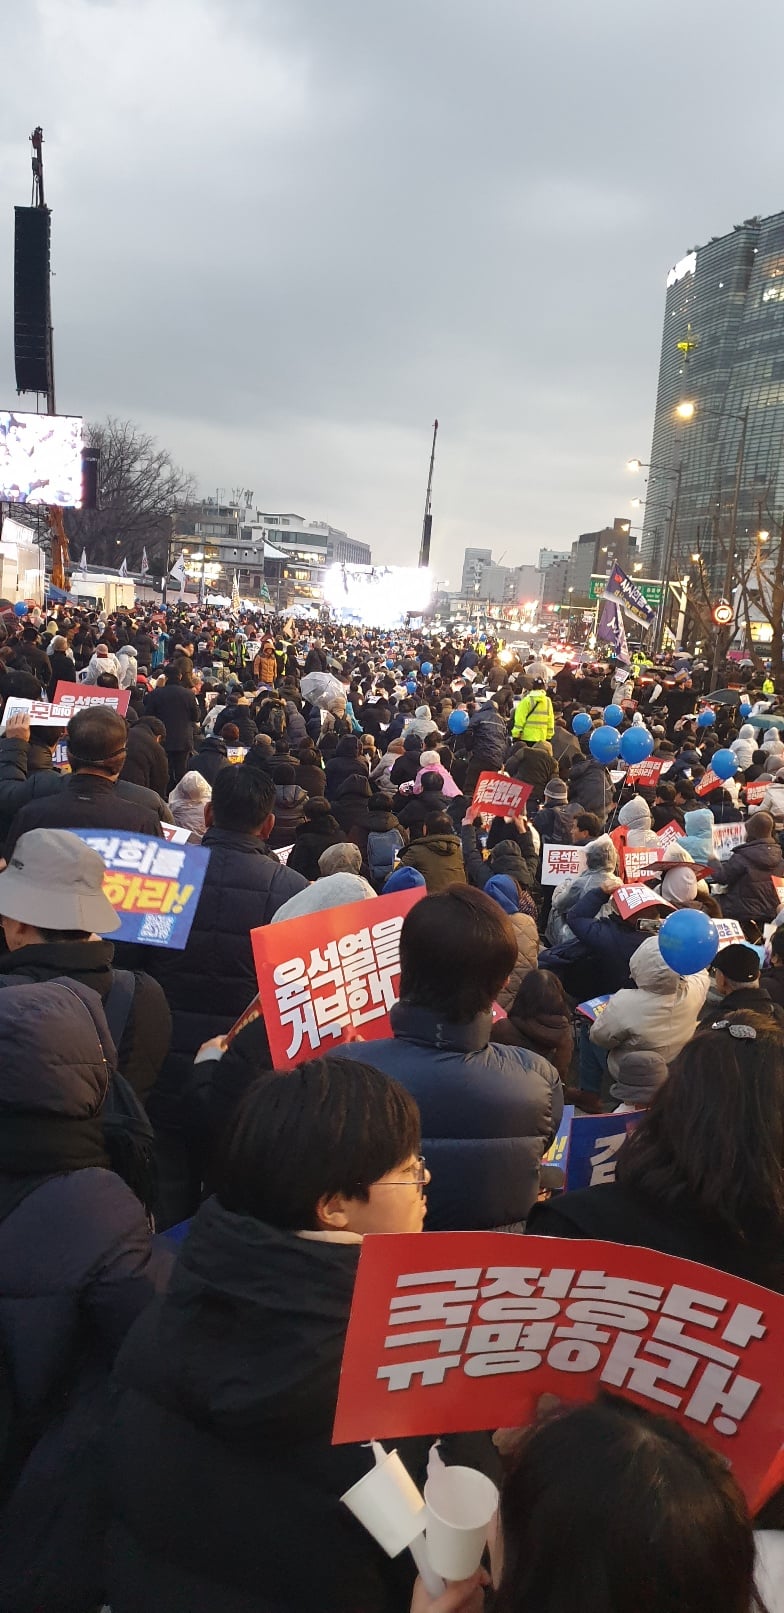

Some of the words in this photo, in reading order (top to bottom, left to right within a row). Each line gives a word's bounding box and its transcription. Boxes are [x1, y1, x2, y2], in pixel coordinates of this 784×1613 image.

[474, 792, 522, 808] 거부한다
[86, 837, 186, 879] 건희를
[625, 851, 658, 866] 김건희를
[103, 871, 194, 915] 하라!
[273, 916, 405, 1013] 윤석열을
[388, 1266, 768, 1369] 국정농단
[377, 1321, 762, 1436] 규명하라!
